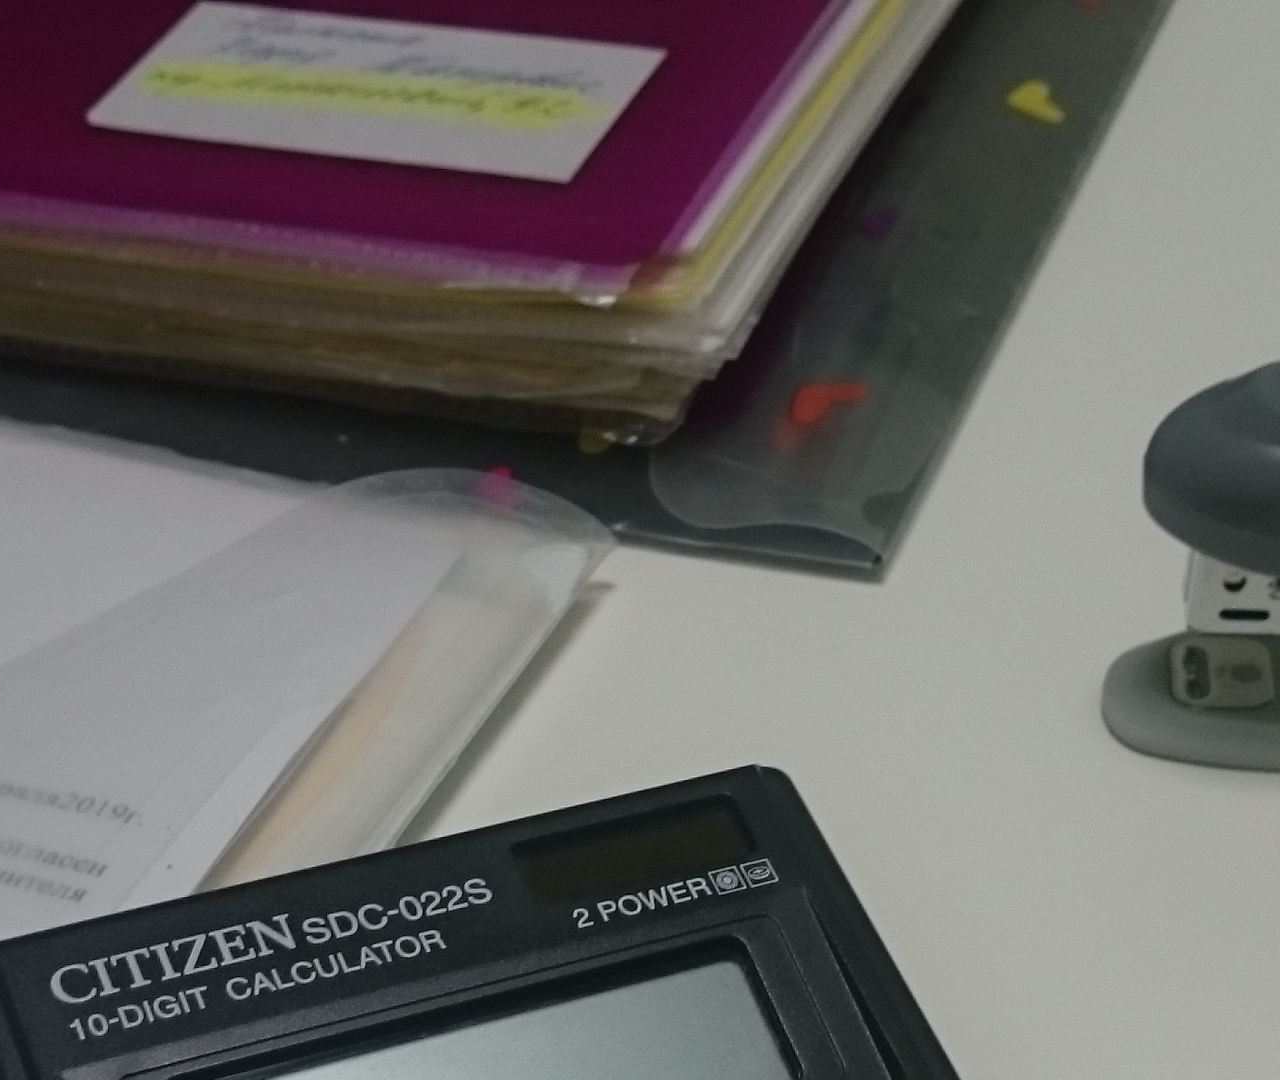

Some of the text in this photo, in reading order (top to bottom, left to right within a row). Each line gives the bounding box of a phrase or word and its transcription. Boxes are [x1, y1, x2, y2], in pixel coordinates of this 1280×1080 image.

[49, 876, 494, 1005] CITIZEN SDC-022S
[571, 874, 714, 931] 2 POWER
[70, 928, 449, 1043] 10-DIGIT CALCULATOR
